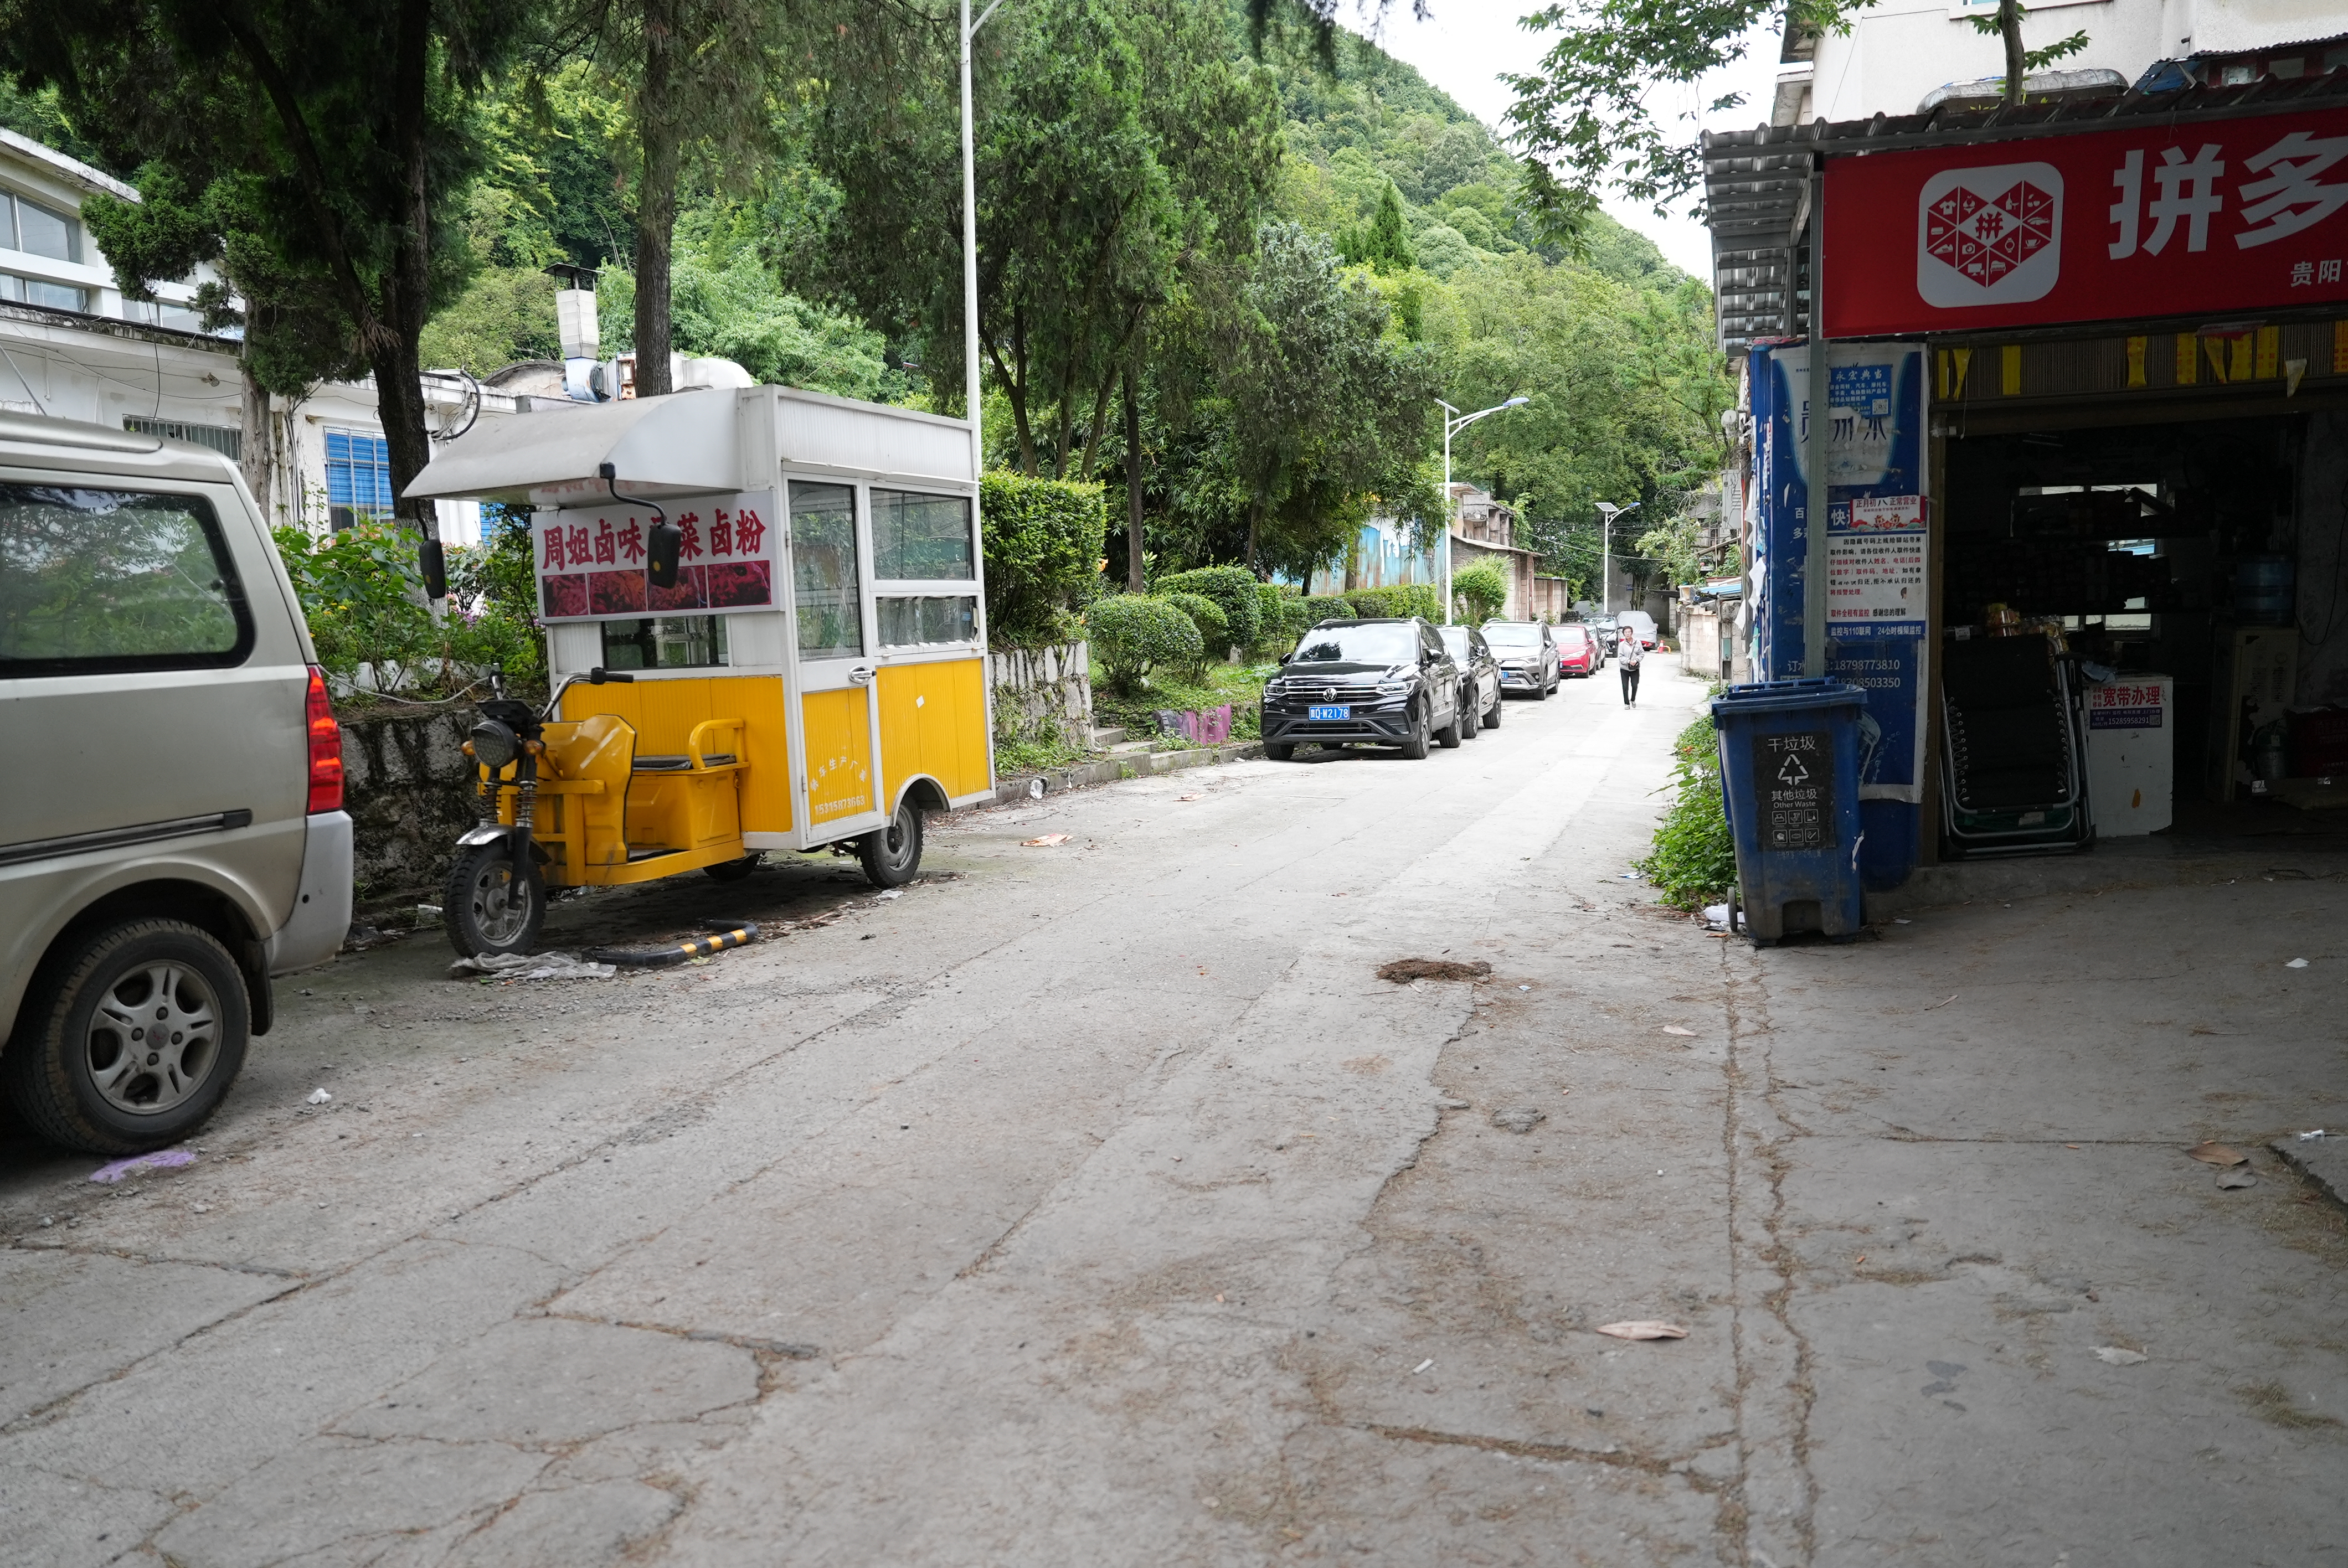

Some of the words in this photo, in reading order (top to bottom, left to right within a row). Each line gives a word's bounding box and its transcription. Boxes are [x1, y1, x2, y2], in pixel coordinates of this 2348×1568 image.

[2109, 131, 2348, 259] 拼多
[1975, 211, 2004, 240] 拼
[2290, 259, 2348, 287] 贵阳
[1794, 507, 1808, 519] 百
[543, 508, 766, 571] 周姐卤味菜卤粉
[1831, 608, 1870, 617] 取件全程有监控
[1872, 608, 1906, 617] 感谢您的理解
[1831, 626, 1871, 636] 监控与110联网
[1877, 625, 1922, 635] 24小时视频监控
[2103, 686, 2160, 707] 宽带办理
[2108, 716, 2149, 725] 15285958291
[1767, 736, 1816, 752] 干垃圾
[1771, 788, 1817, 802] 其他垃圾
